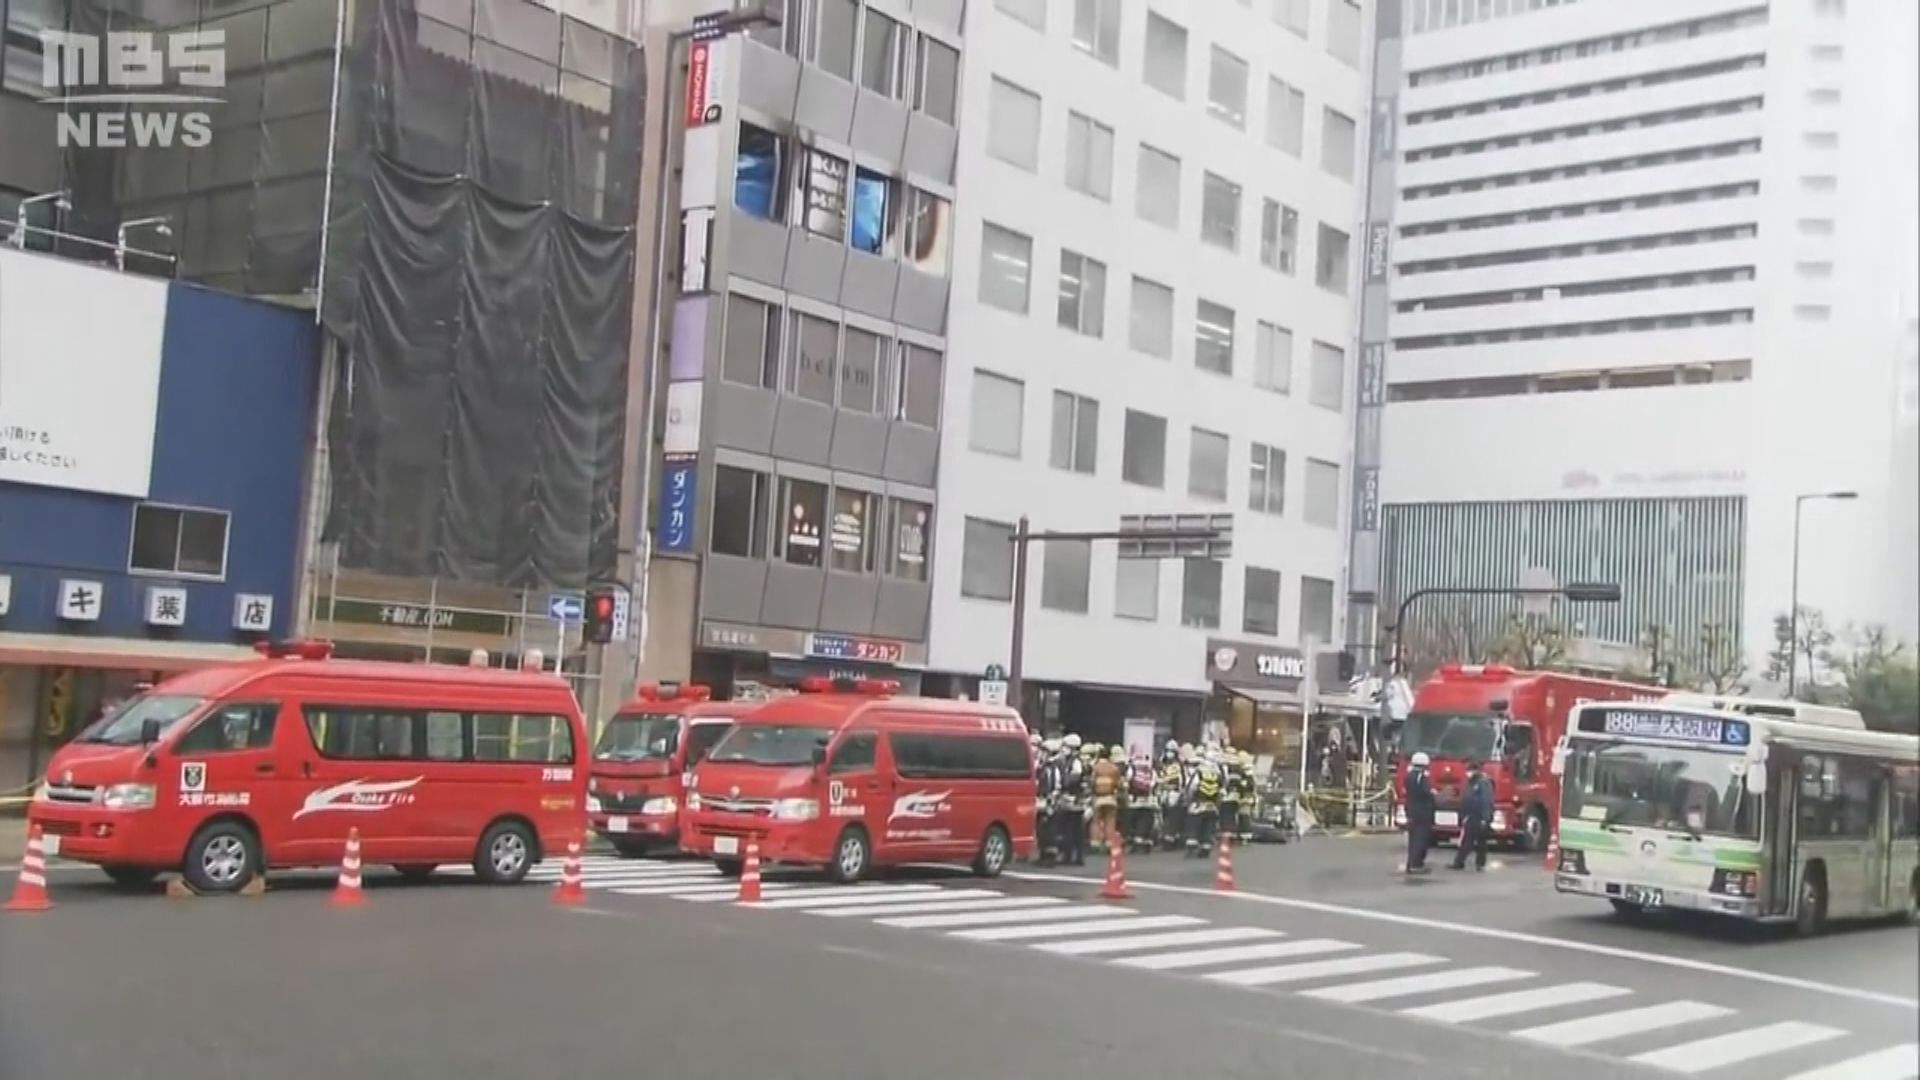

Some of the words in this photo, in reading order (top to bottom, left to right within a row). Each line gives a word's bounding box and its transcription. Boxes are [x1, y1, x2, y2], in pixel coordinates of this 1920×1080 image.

[668, 469, 688, 546] ダンカン
[857, 641, 899, 659] ダンカン
[1662, 714, 1720, 742] 大阪駅
